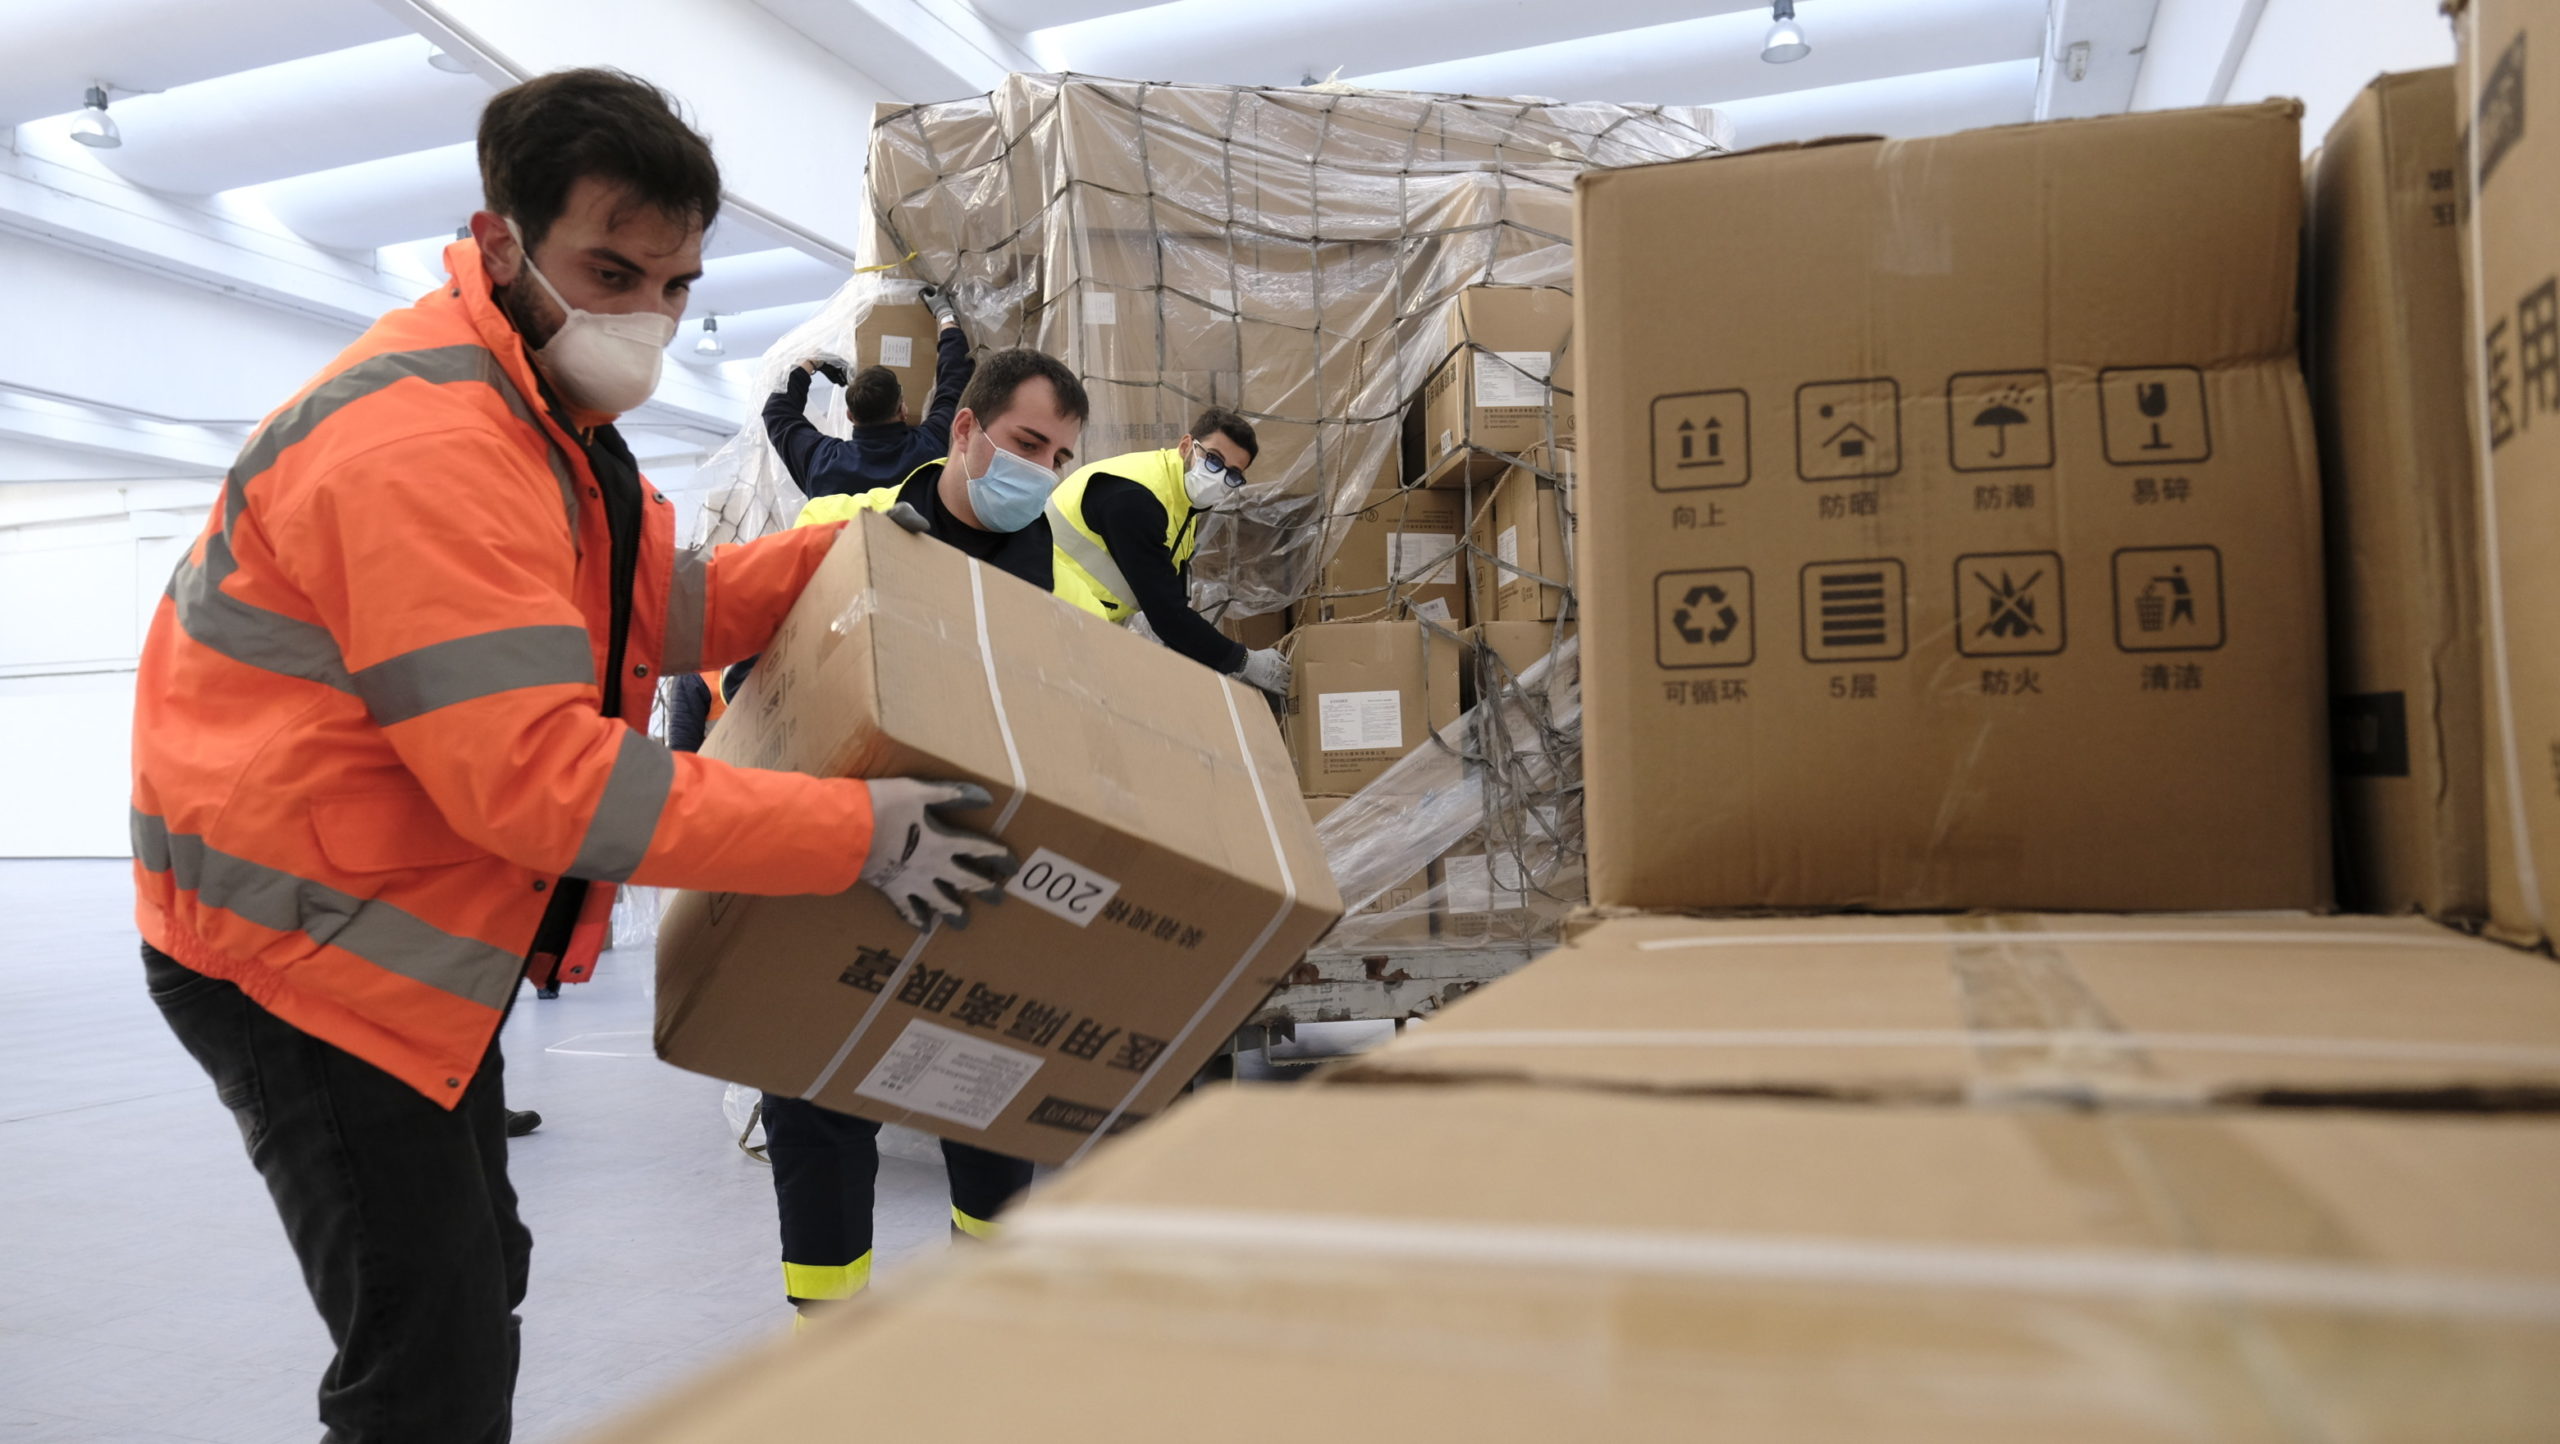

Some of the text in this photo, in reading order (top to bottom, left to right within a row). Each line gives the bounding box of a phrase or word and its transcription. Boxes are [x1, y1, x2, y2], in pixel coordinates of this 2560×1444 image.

[1818, 490, 1880, 519] 防晒
[1973, 483, 2035, 512] 防潮
[2131, 475, 2192, 505] 易碎
[1671, 502, 1727, 530] 向上
[1828, 672, 1878, 699] 5层
[1980, 666, 2042, 696] 防火
[2139, 660, 2203, 692] 清洁
[1661, 677, 1749, 706] 可循环
[1021, 861, 1104, 914] 200
[837, 945, 1174, 1076] 医用隔离眼罩
